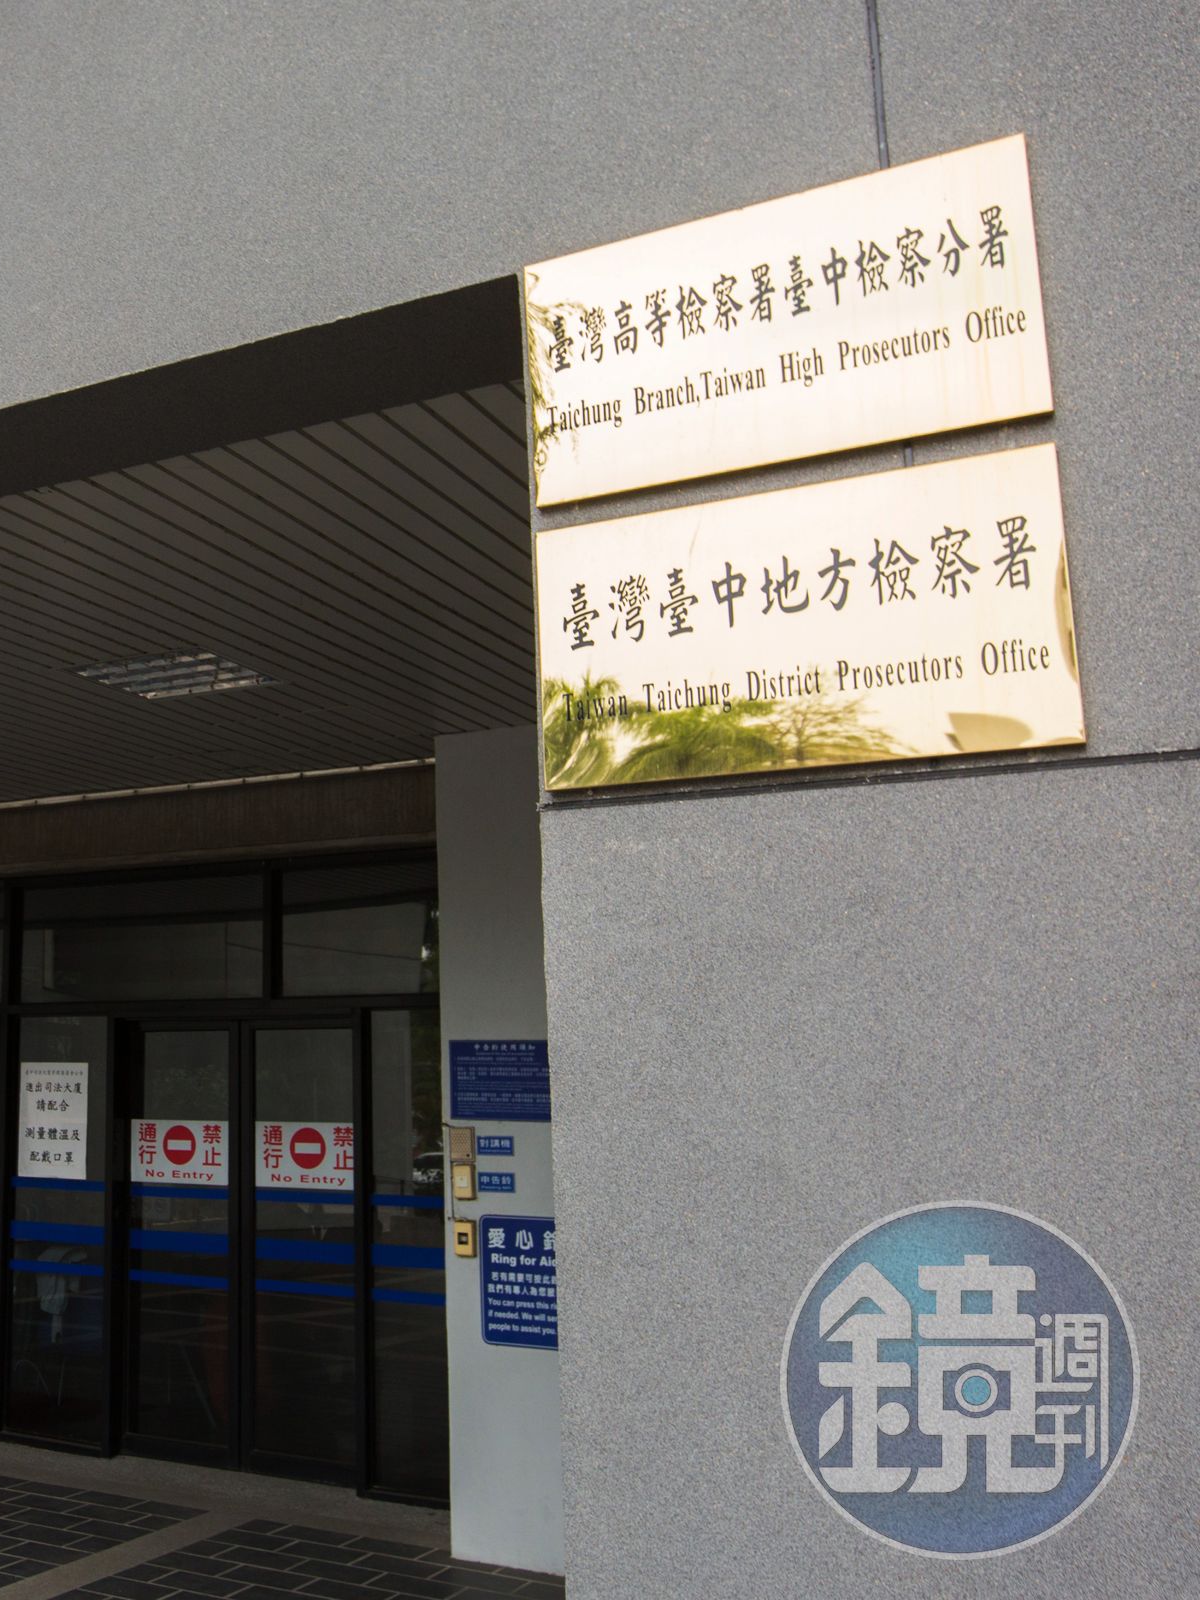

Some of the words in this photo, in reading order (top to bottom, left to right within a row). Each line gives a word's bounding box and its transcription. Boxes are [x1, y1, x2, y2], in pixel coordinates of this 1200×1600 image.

[547, 205, 1009, 374] 臺灣高等檢察署臺中檢察分署
[547, 396, 623, 433] Taichung
[779, 349, 825, 387] High
[838, 324, 950, 372] Prosecutors
[965, 307, 1027, 344] Office
[562, 515, 1037, 651] 臺灣臺中地方檢察署
[562, 691, 628, 723] Taiwan
[642, 679, 732, 714] Taichung
[746, 666, 822, 703] District
[837, 652, 963, 692] Prosecutors
[981, 641, 1050, 676] Office
[25, 1082, 83, 1095] 進出司法大廈
[36, 1099, 69, 1112] 請配合
[25, 1127, 80, 1141] 測量體溫及
[139, 1123, 157, 1164] 通行
[202, 1124, 221, 1167] 禁止
[263, 1125, 283, 1168] 通行
[333, 1126, 354, 1170] 禁止
[145, 1168, 165, 1178] No
[172, 1170, 214, 1181] Entry
[271, 1174, 291, 1183] No
[300, 1174, 345, 1186] Entry
[491, 1253, 517, 1267] Ring
[519, 1255, 537, 1266] for
[488, 1297, 501, 1306] You
[516, 1301, 535, 1309] press
[536, 1301, 549, 1309] this
[521, 1312, 533, 1320] We
[488, 1323, 511, 1332] people
